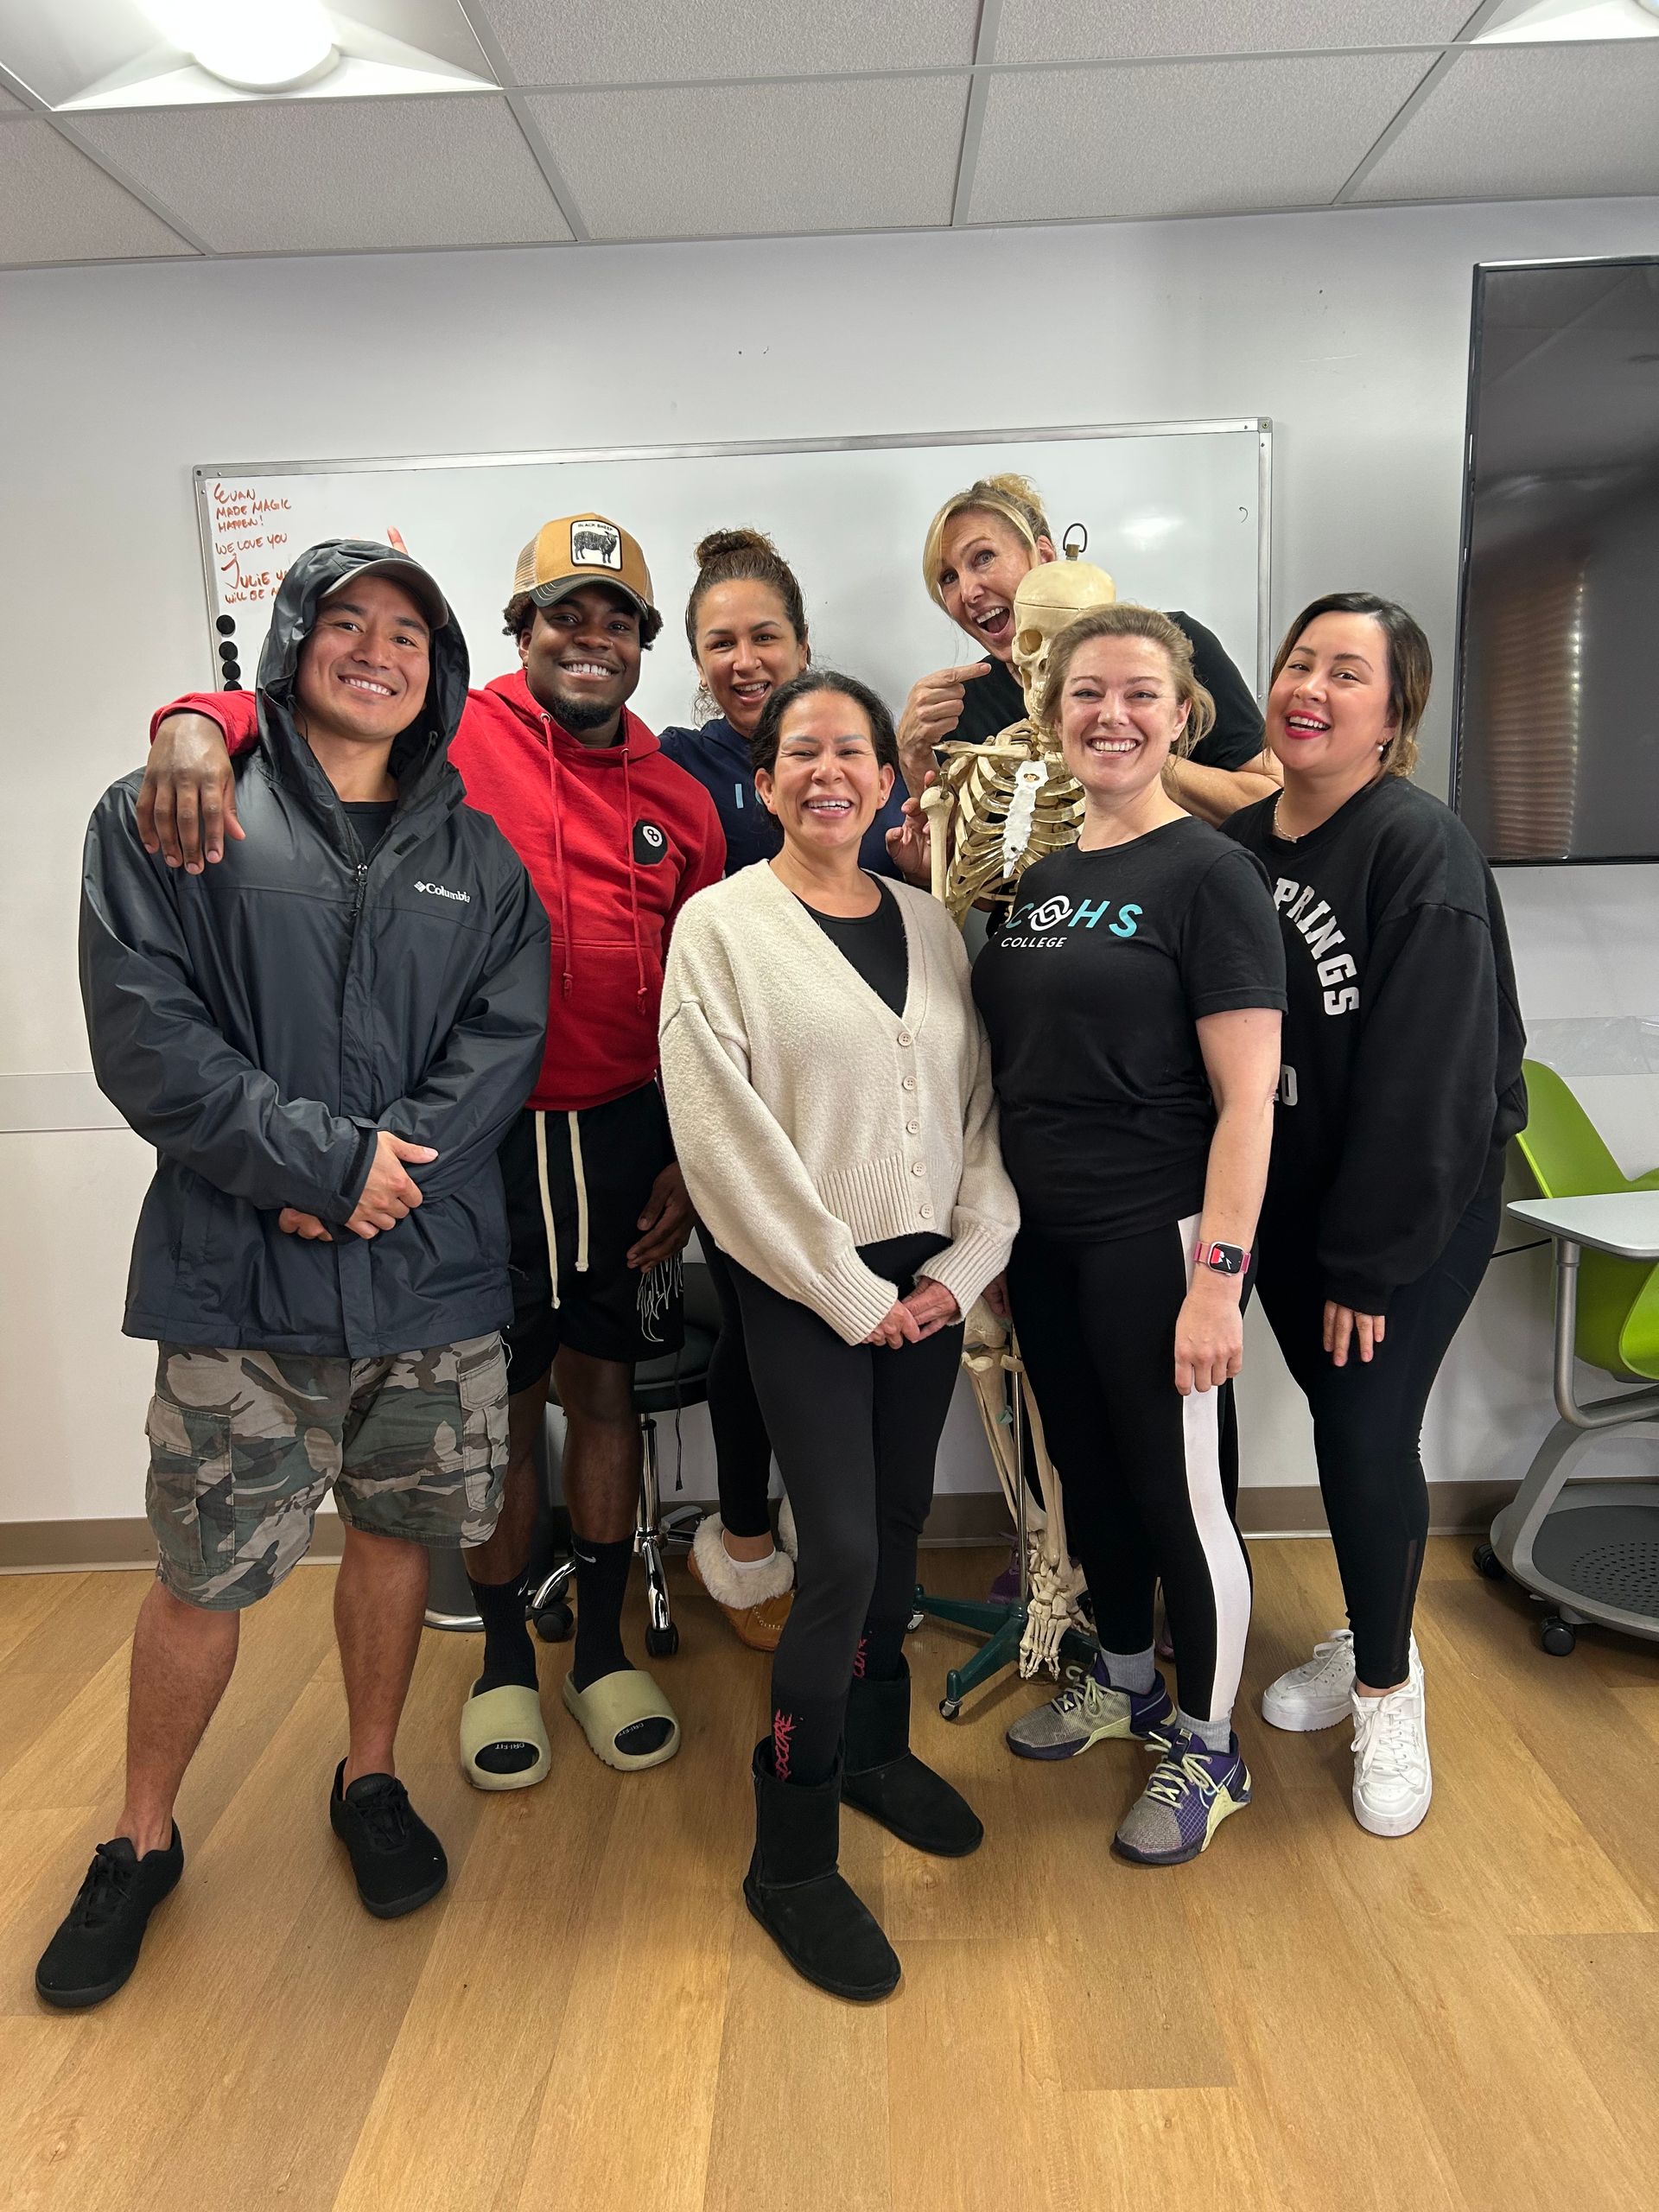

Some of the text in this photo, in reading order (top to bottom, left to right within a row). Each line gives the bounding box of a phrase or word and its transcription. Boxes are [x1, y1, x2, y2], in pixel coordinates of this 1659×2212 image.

[217, 498, 292, 520] MADE MAGIC
[215, 532, 288, 555] WE LOVE YOU
[249, 589, 265, 601] BE
[425, 882, 472, 904] Columbia
[1001, 937, 1068, 948] COLLEGE
